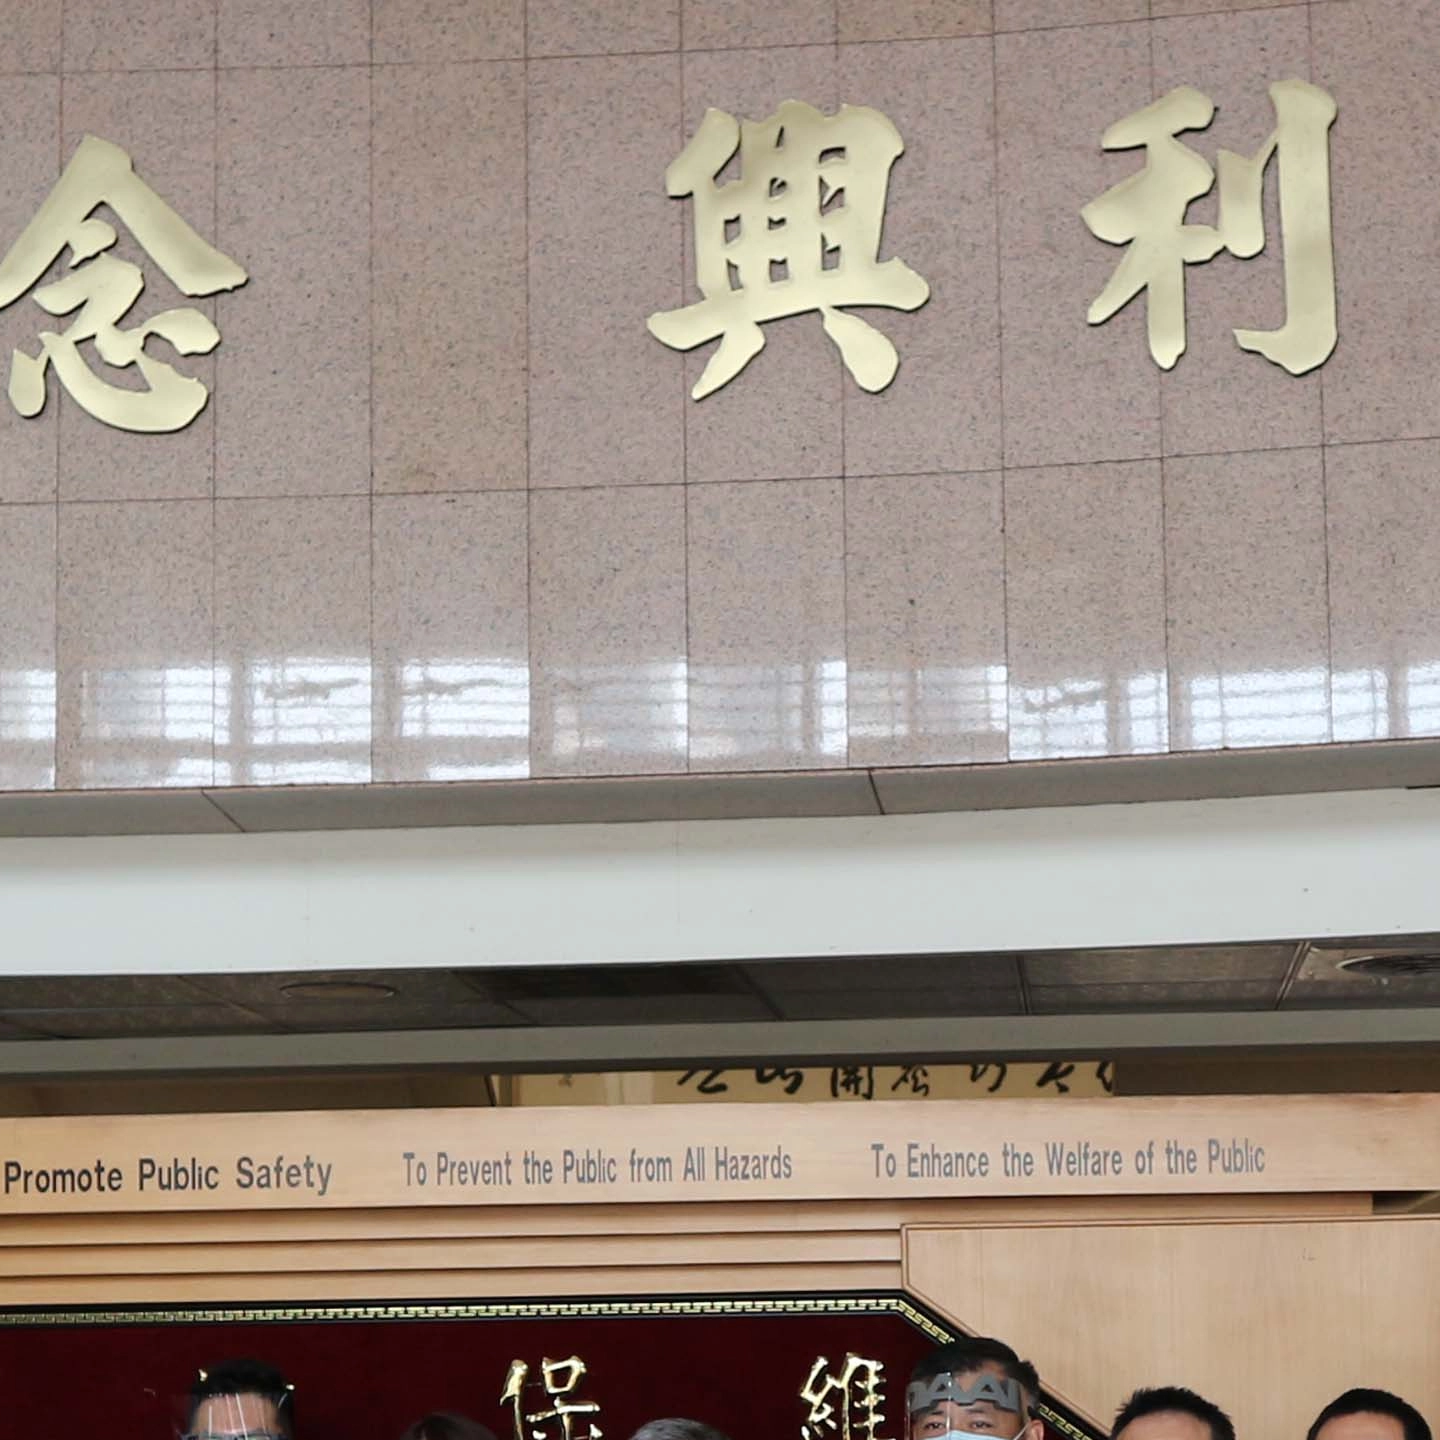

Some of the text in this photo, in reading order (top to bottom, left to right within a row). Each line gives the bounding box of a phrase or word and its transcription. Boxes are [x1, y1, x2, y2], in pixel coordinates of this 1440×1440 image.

[5, 1160, 122, 1194] Promote
[139, 1158, 218, 1190] Public
[236, 1156, 331, 1195] Safety
[403, 1146, 791, 1186] To Prevent the Public from All Hazards
[871, 1138, 1264, 1177] To Enhance the Welfare of the Public
